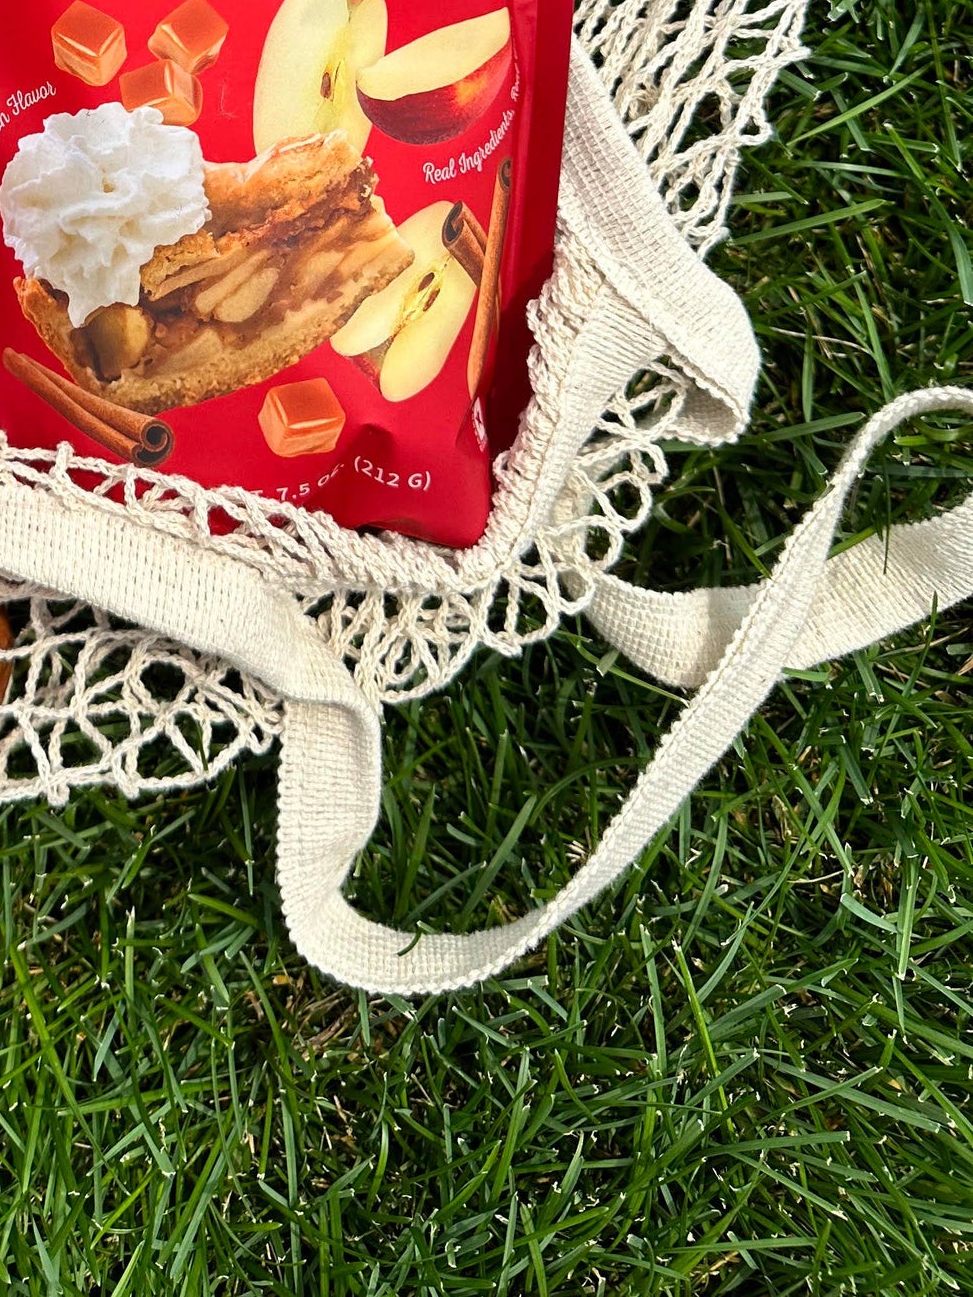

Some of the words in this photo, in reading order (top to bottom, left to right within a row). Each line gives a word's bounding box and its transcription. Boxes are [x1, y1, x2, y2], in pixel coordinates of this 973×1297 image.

[6, 81, 57, 116] Flavor
[422, 158, 457, 184] Real
[458, 109, 515, 172] Ingredients,
[276, 482, 311, 501] 7.5
[354, 455, 401, 487] (212
[407, 470, 432, 491] G)
